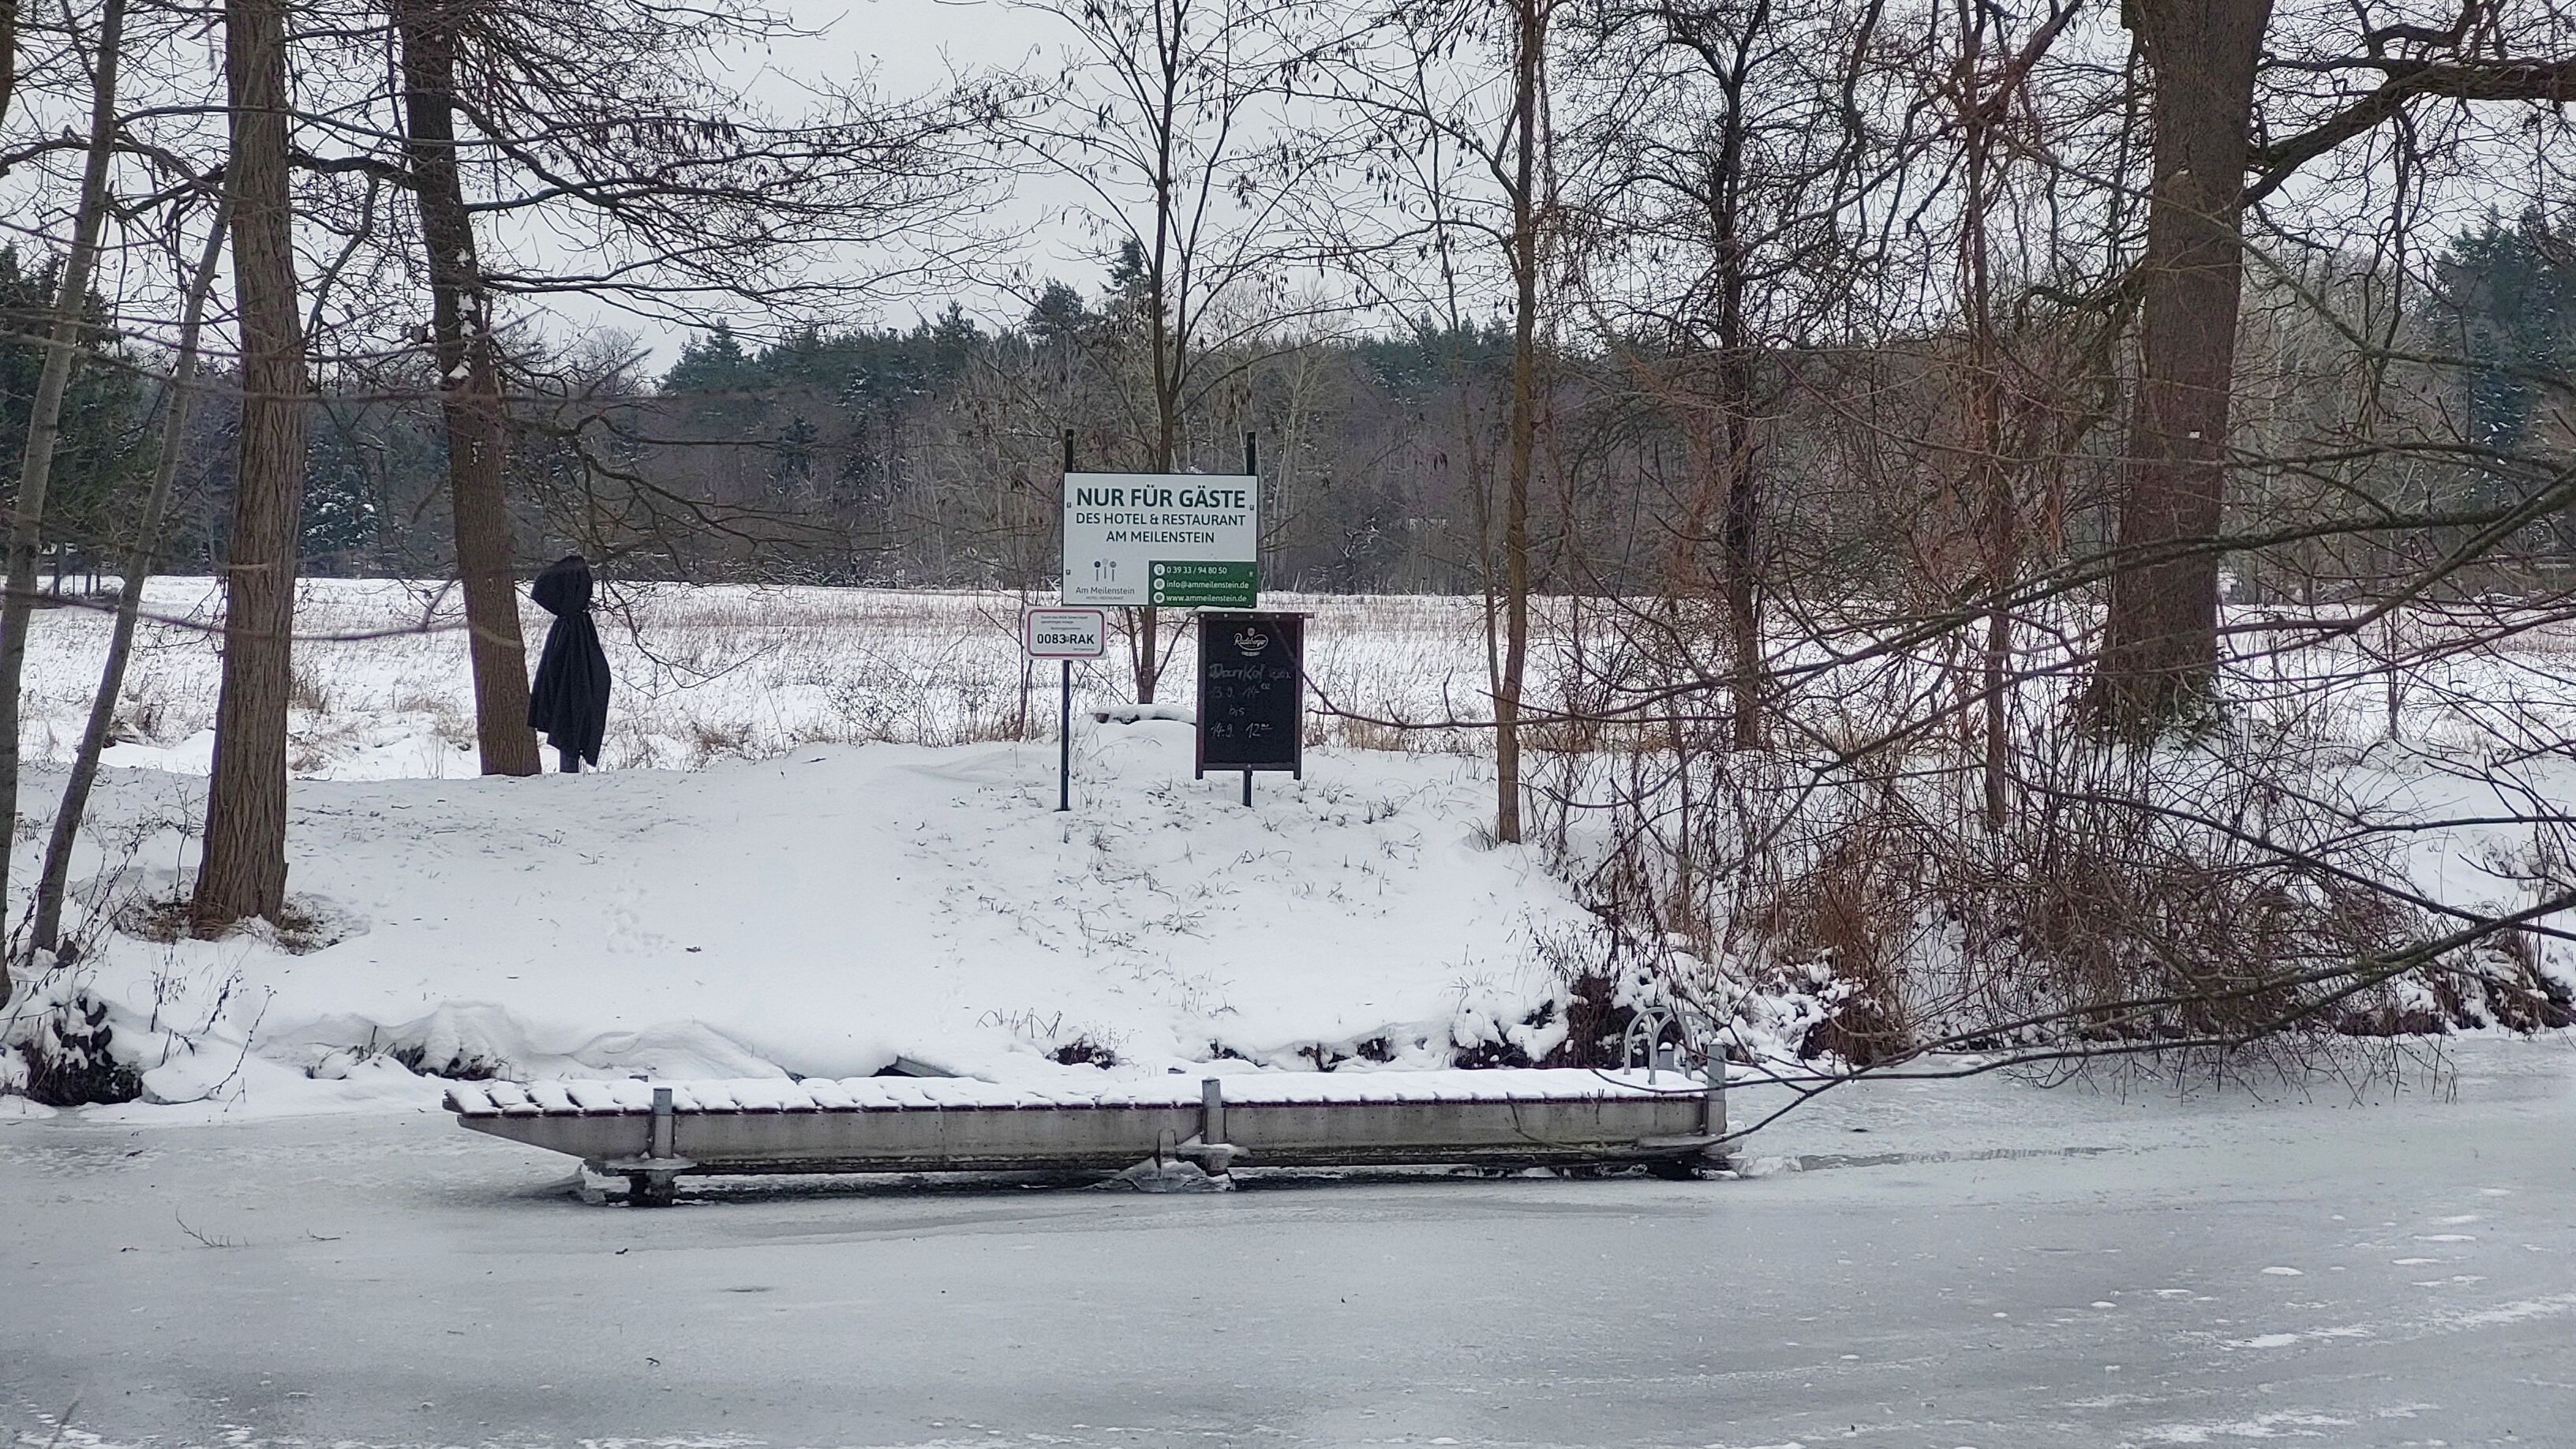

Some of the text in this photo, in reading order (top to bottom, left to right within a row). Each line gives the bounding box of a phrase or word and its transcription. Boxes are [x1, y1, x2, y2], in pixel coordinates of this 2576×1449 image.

[1076, 484, 1245, 508] NUR FÜR GÄSTE
[1076, 513, 1246, 526] DES HOTEL & RESTAURANT
[1106, 531, 1215, 543] AM MEILENSTEIN
[1090, 586, 1135, 595] Meilenstein
[1166, 580, 1249, 589] info@ammeilenstein.de
